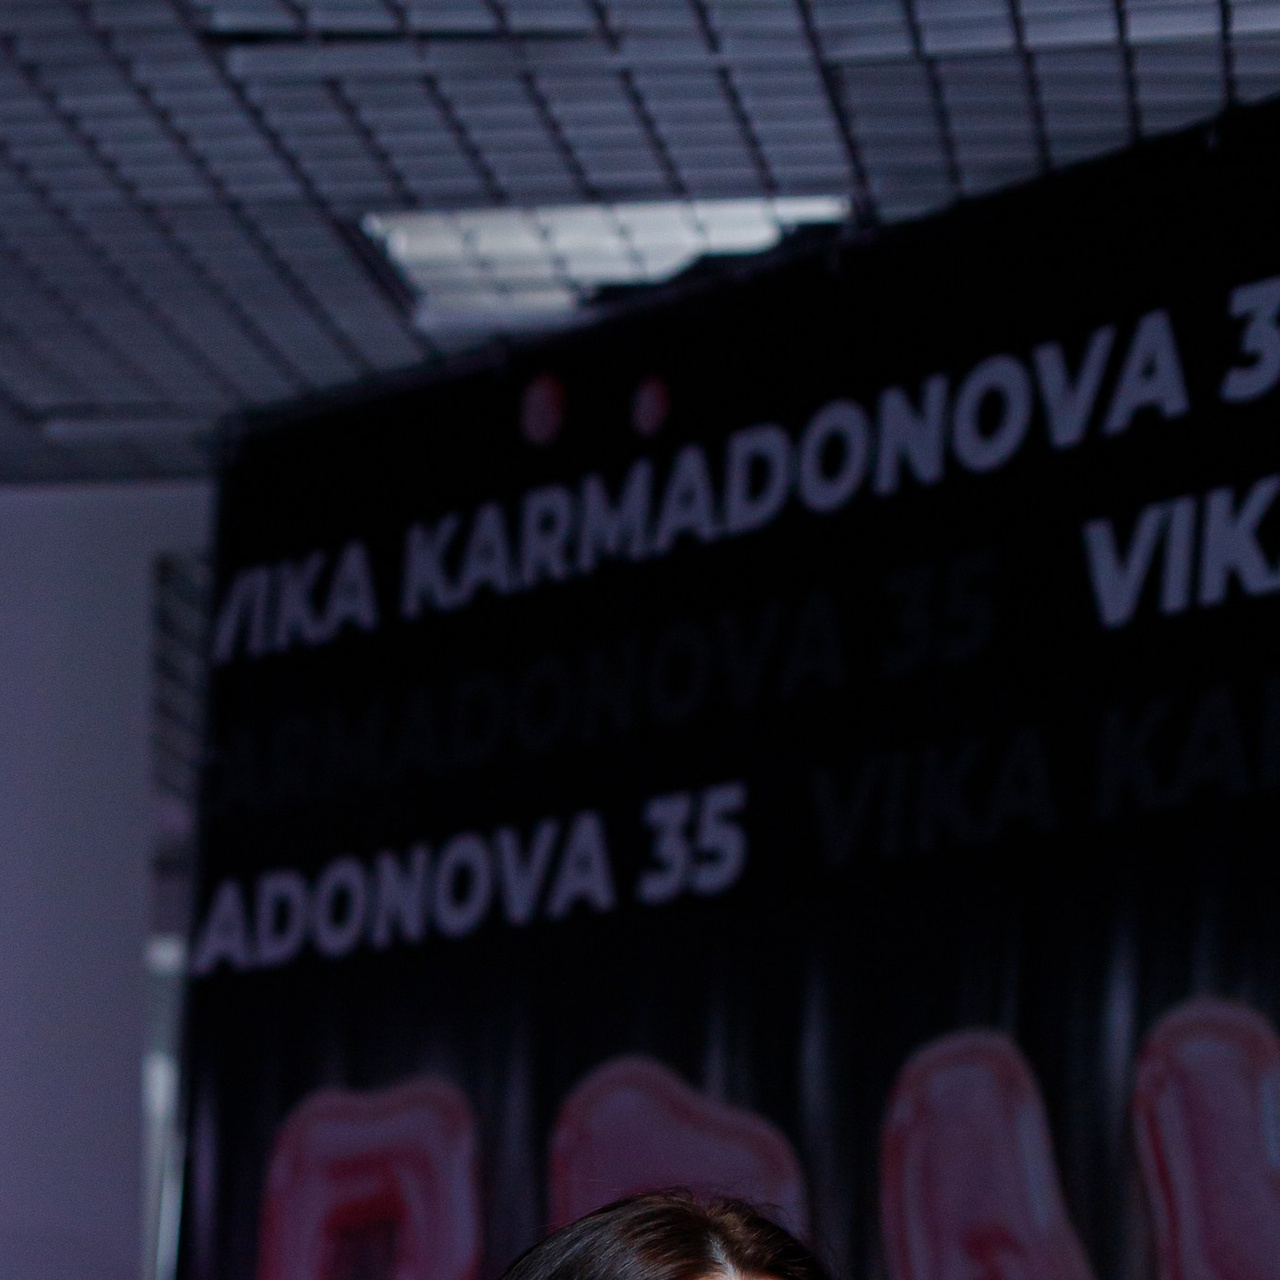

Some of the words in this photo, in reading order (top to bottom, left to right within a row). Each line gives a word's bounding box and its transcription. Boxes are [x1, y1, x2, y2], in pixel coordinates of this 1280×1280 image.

[398, 302, 1193, 625] KARMADONOVA
[878, 544, 999, 680] 35
[190, 804, 617, 979] ADONOVA
[633, 780, 751, 904] 35
[812, 724, 1058, 871] VIKA
